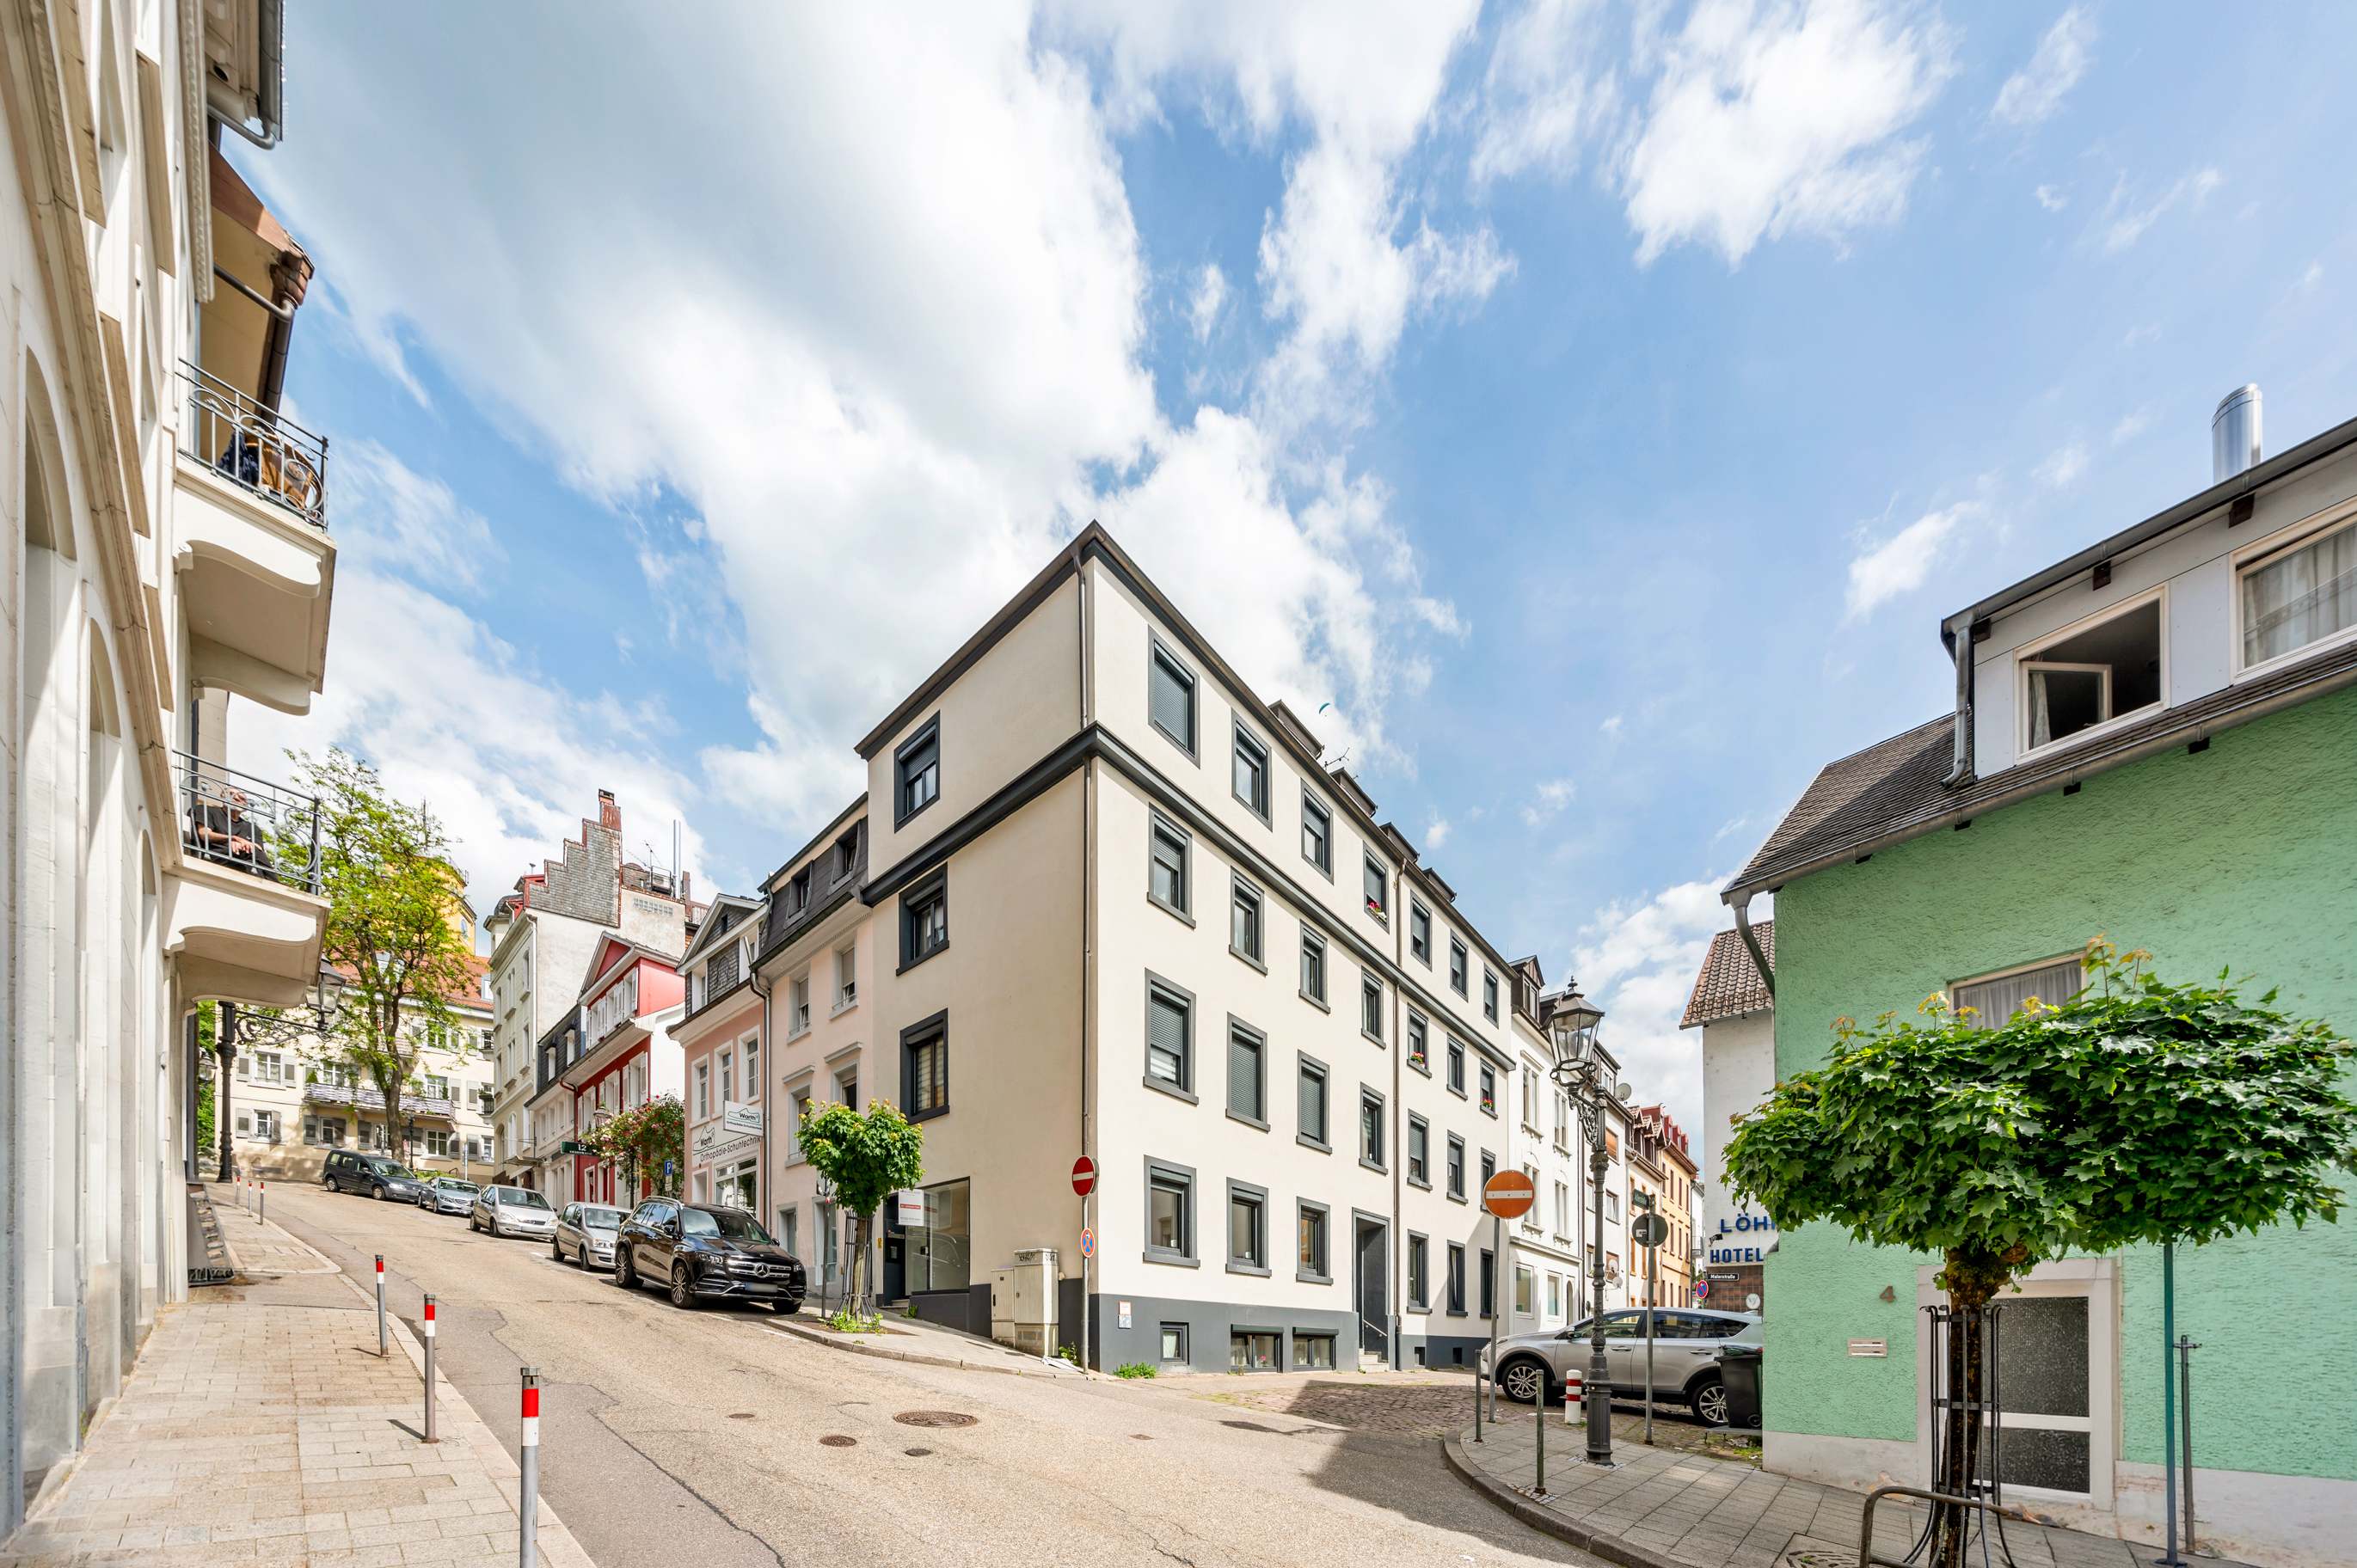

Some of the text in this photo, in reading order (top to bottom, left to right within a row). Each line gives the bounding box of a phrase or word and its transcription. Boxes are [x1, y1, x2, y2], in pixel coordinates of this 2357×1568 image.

[577, 1143, 587, 1152] 12
[700, 1136, 713, 1147] Warth
[666, 1161, 672, 1174] P
[1709, 1247, 1764, 1263] HOTEL
[1879, 1285, 1896, 1302] 4
